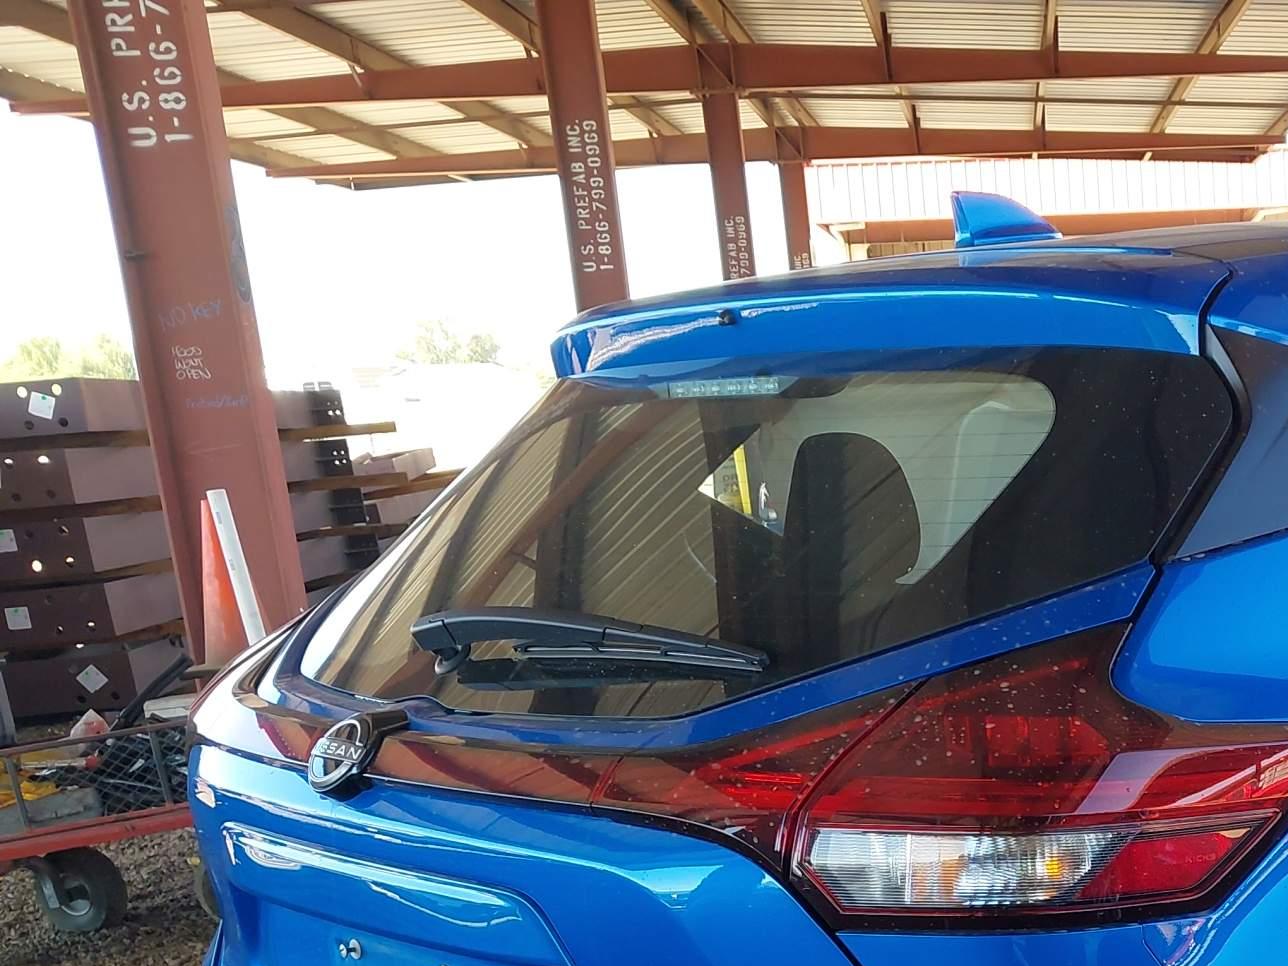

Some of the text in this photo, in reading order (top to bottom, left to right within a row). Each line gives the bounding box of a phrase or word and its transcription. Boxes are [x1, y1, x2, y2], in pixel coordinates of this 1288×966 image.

[121, 79, 158, 147] U.S.
[566, 119, 597, 272] U.S. PREFAB INC.
[583, 120, 614, 270] 1-866-799-0969
[176, 367, 212, 380] OPEN
[314, 740, 362, 760] SSAN
